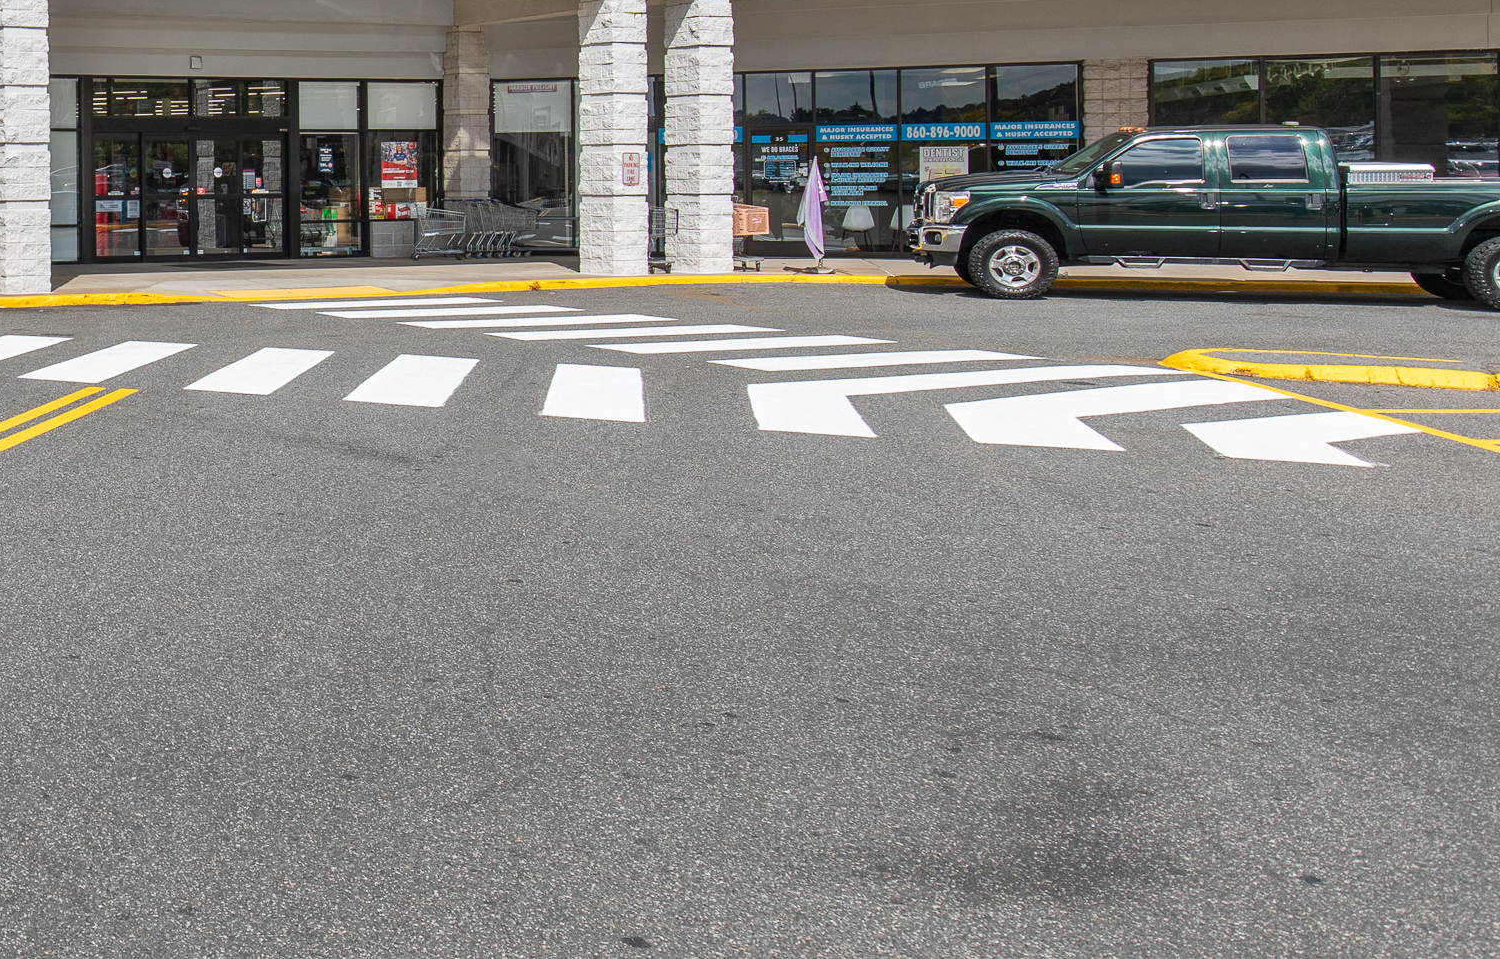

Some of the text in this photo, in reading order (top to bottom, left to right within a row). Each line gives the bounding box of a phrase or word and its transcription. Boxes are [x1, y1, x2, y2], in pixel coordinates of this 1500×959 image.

[906, 125, 981, 139] 860-896-9000
[779, 145, 799, 153] BRACES
[923, 148, 965, 158] DENTIST
